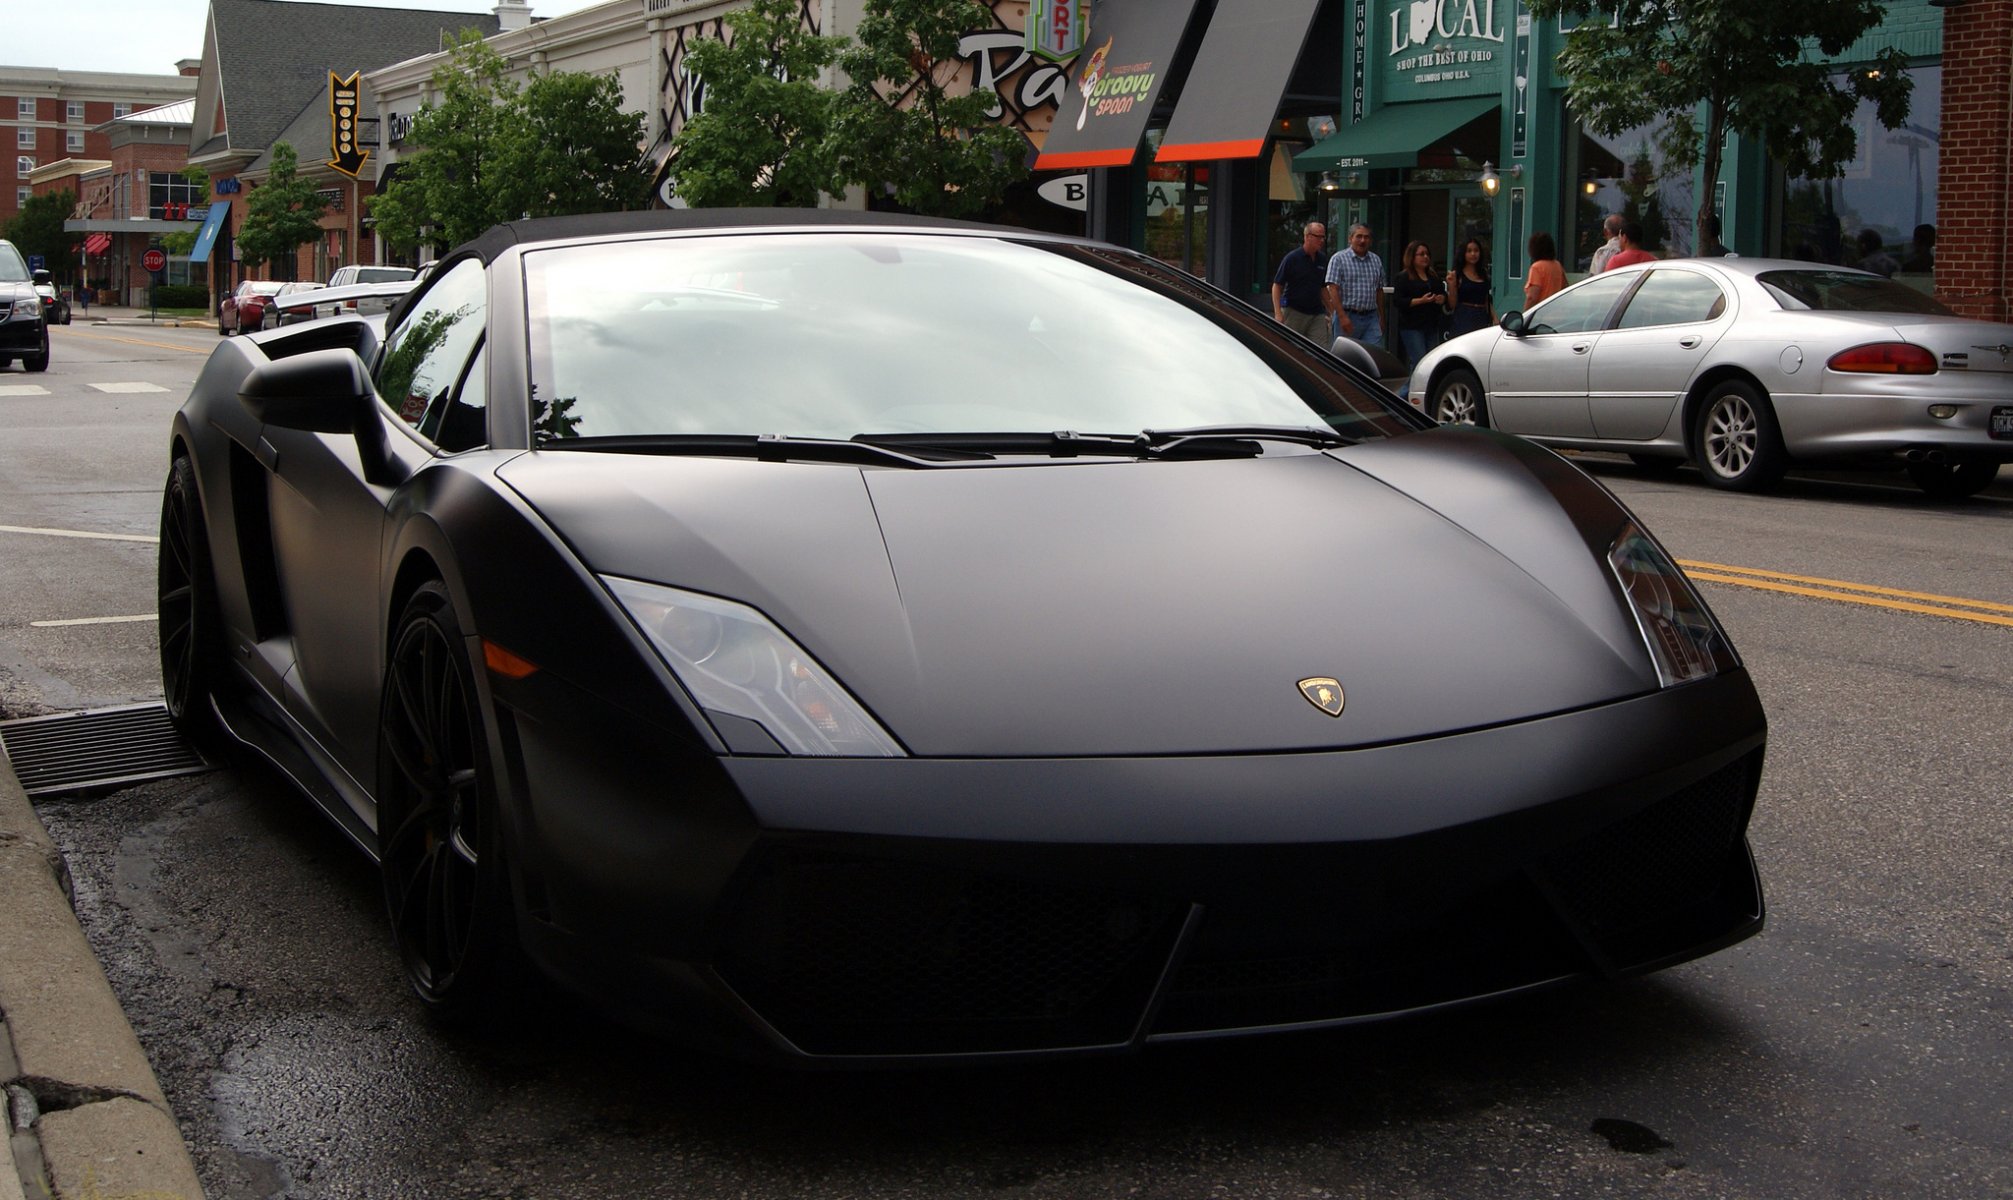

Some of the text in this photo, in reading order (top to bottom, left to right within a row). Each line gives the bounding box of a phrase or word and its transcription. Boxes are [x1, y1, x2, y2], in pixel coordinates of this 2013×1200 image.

[1356, 4, 1365, 64] HOME
[1396, 50, 1492, 71] SHOP THE BEST OF OHIO
[145, 256, 164, 265] STOP
